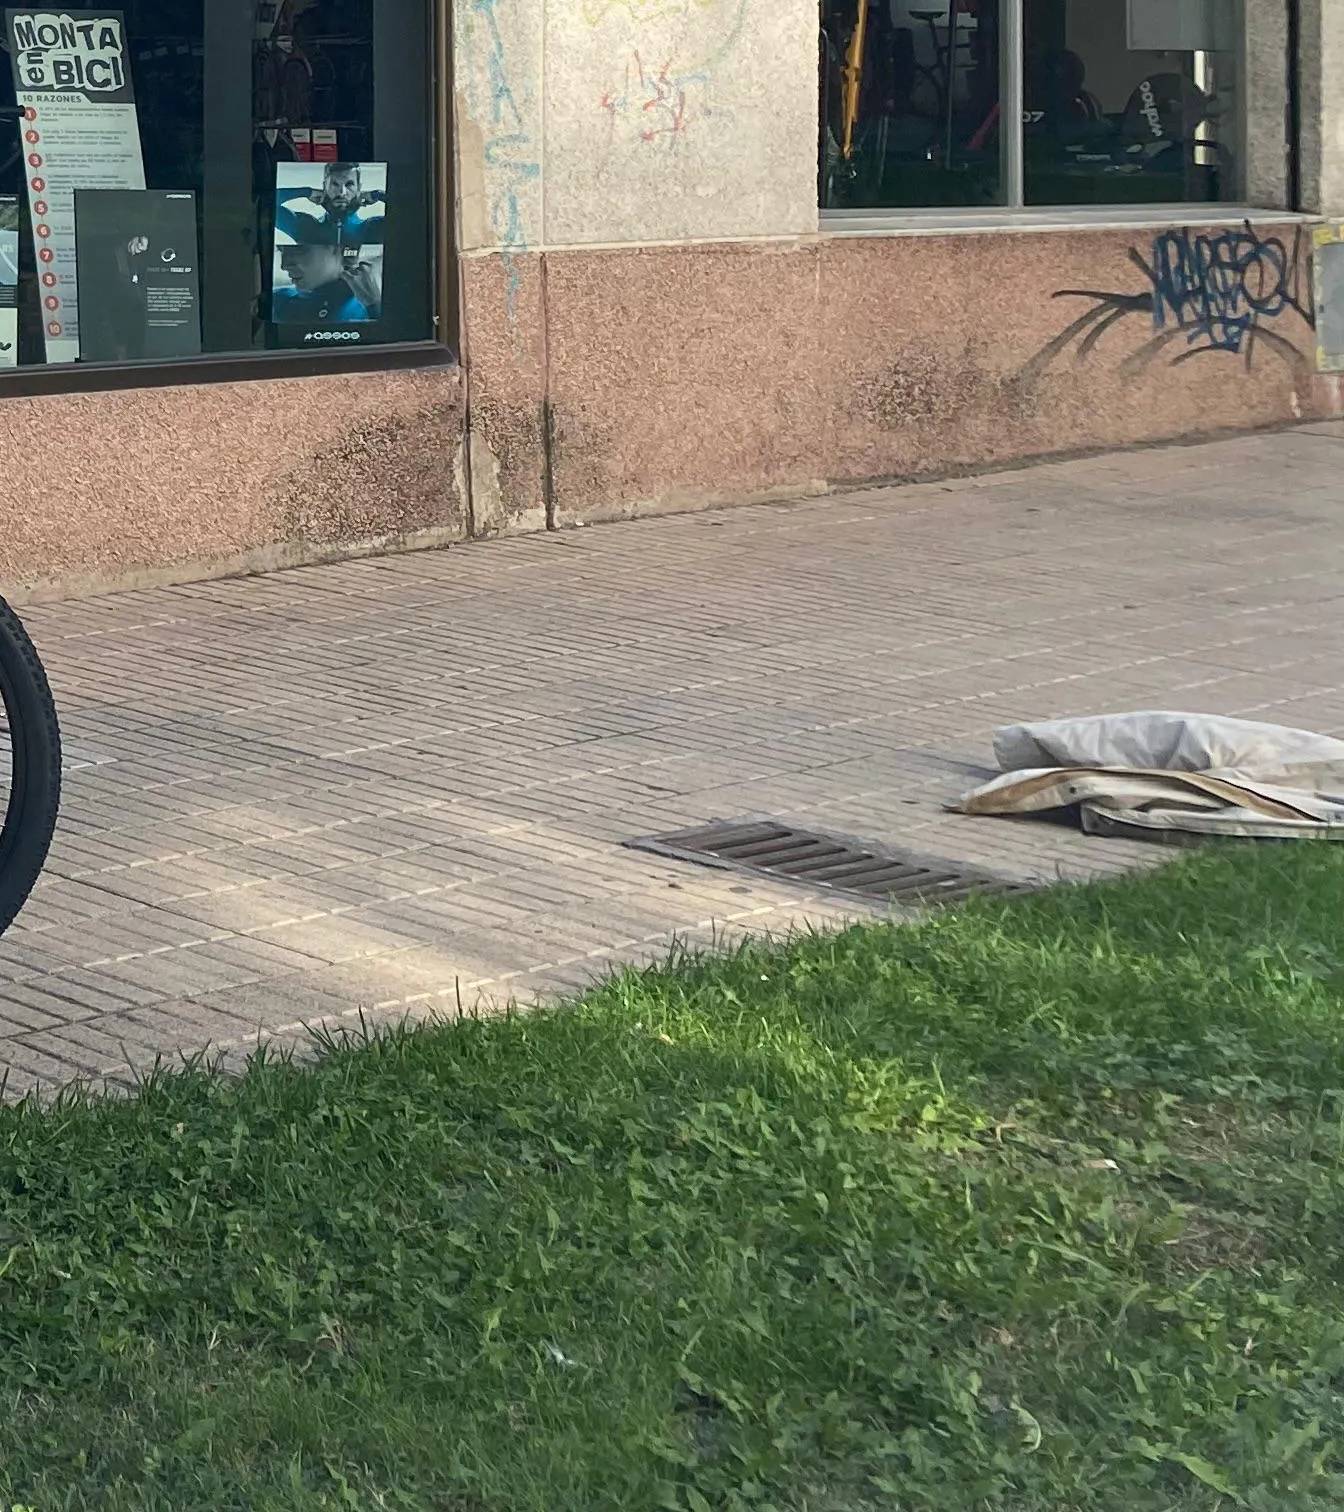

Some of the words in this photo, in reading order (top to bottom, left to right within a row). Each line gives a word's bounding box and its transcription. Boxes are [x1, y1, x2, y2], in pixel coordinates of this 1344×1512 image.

[15, 21, 120, 51] MONTA
[26, 52, 45, 84] en
[53, 55, 123, 88] BICI
[23, 94, 33, 103] 10
[37, 94, 82, 103] RAZONES
[1139, 80, 1163, 137] wahoo
